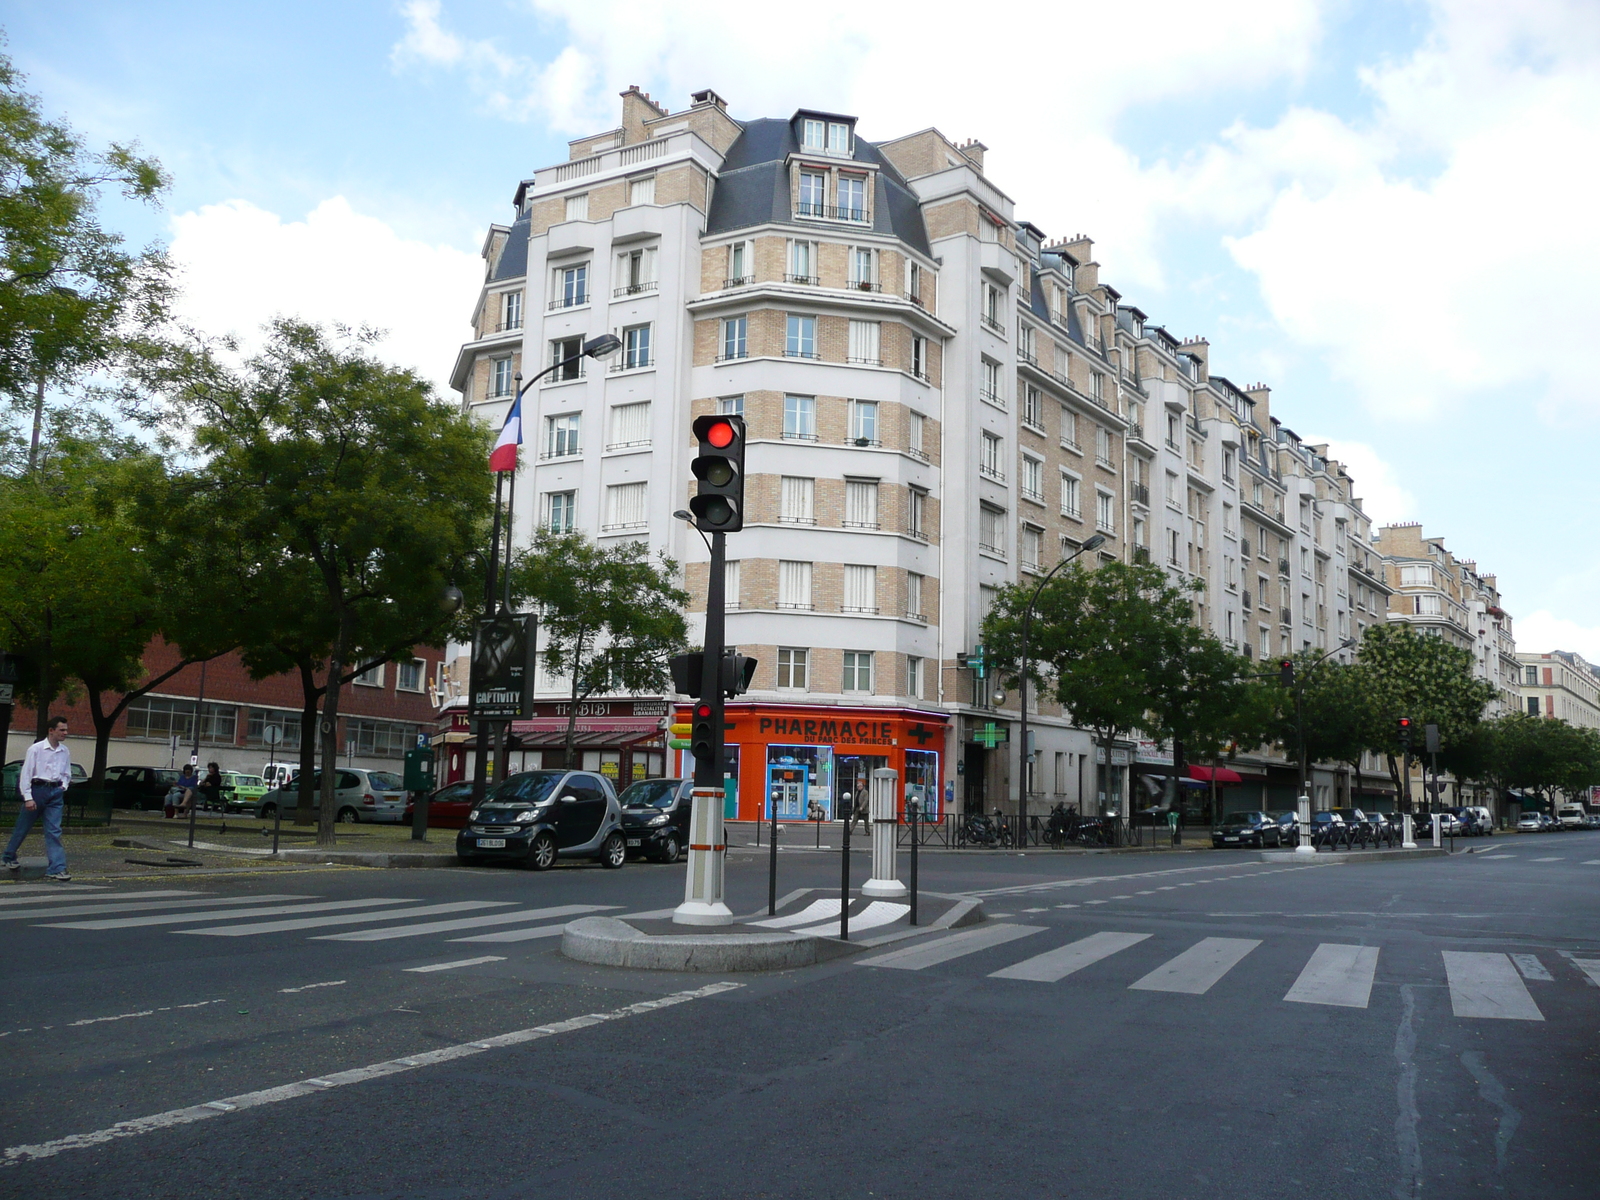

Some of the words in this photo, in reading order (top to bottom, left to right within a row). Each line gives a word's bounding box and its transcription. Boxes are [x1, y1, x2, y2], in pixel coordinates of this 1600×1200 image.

[476, 691, 521, 704] CAPTIVITY
[760, 717, 893, 739] PHARMACIE
[804, 735, 815, 743] DU
[818, 736, 838, 744] PARC
[859, 737, 893, 746] PRINCES
